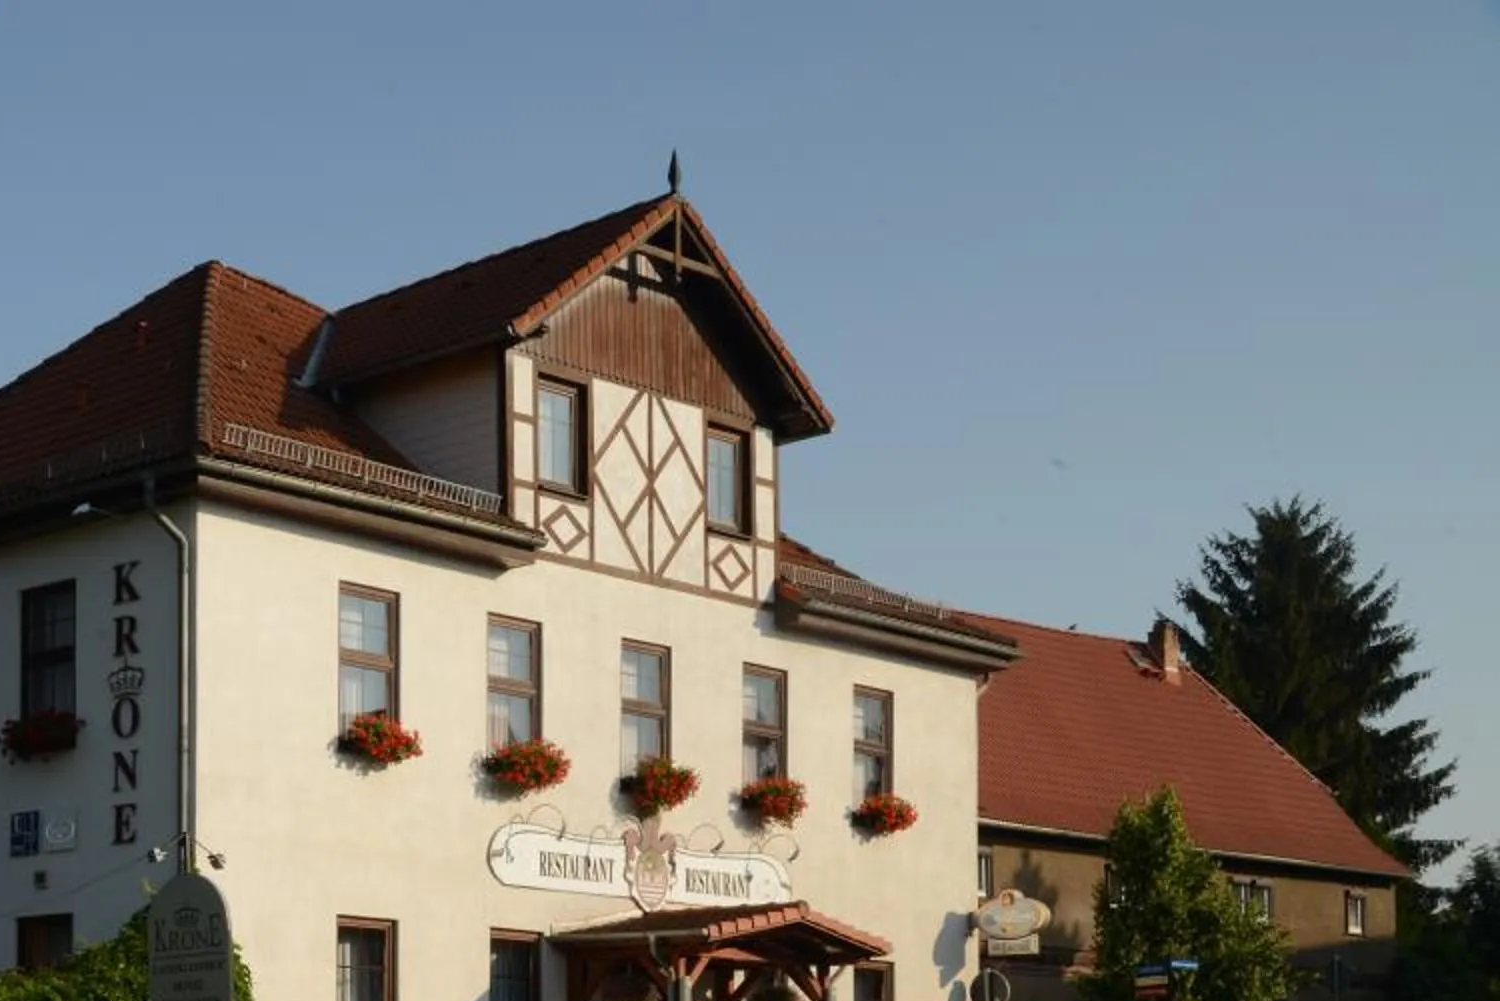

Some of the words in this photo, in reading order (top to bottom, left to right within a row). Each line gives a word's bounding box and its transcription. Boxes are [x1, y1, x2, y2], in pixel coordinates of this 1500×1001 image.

[111, 560, 142, 846] KRONE
[539, 851, 614, 884] RESTAURANT
[685, 868, 751, 898] RESTAURANT
[154, 913, 222, 953] KRONE
